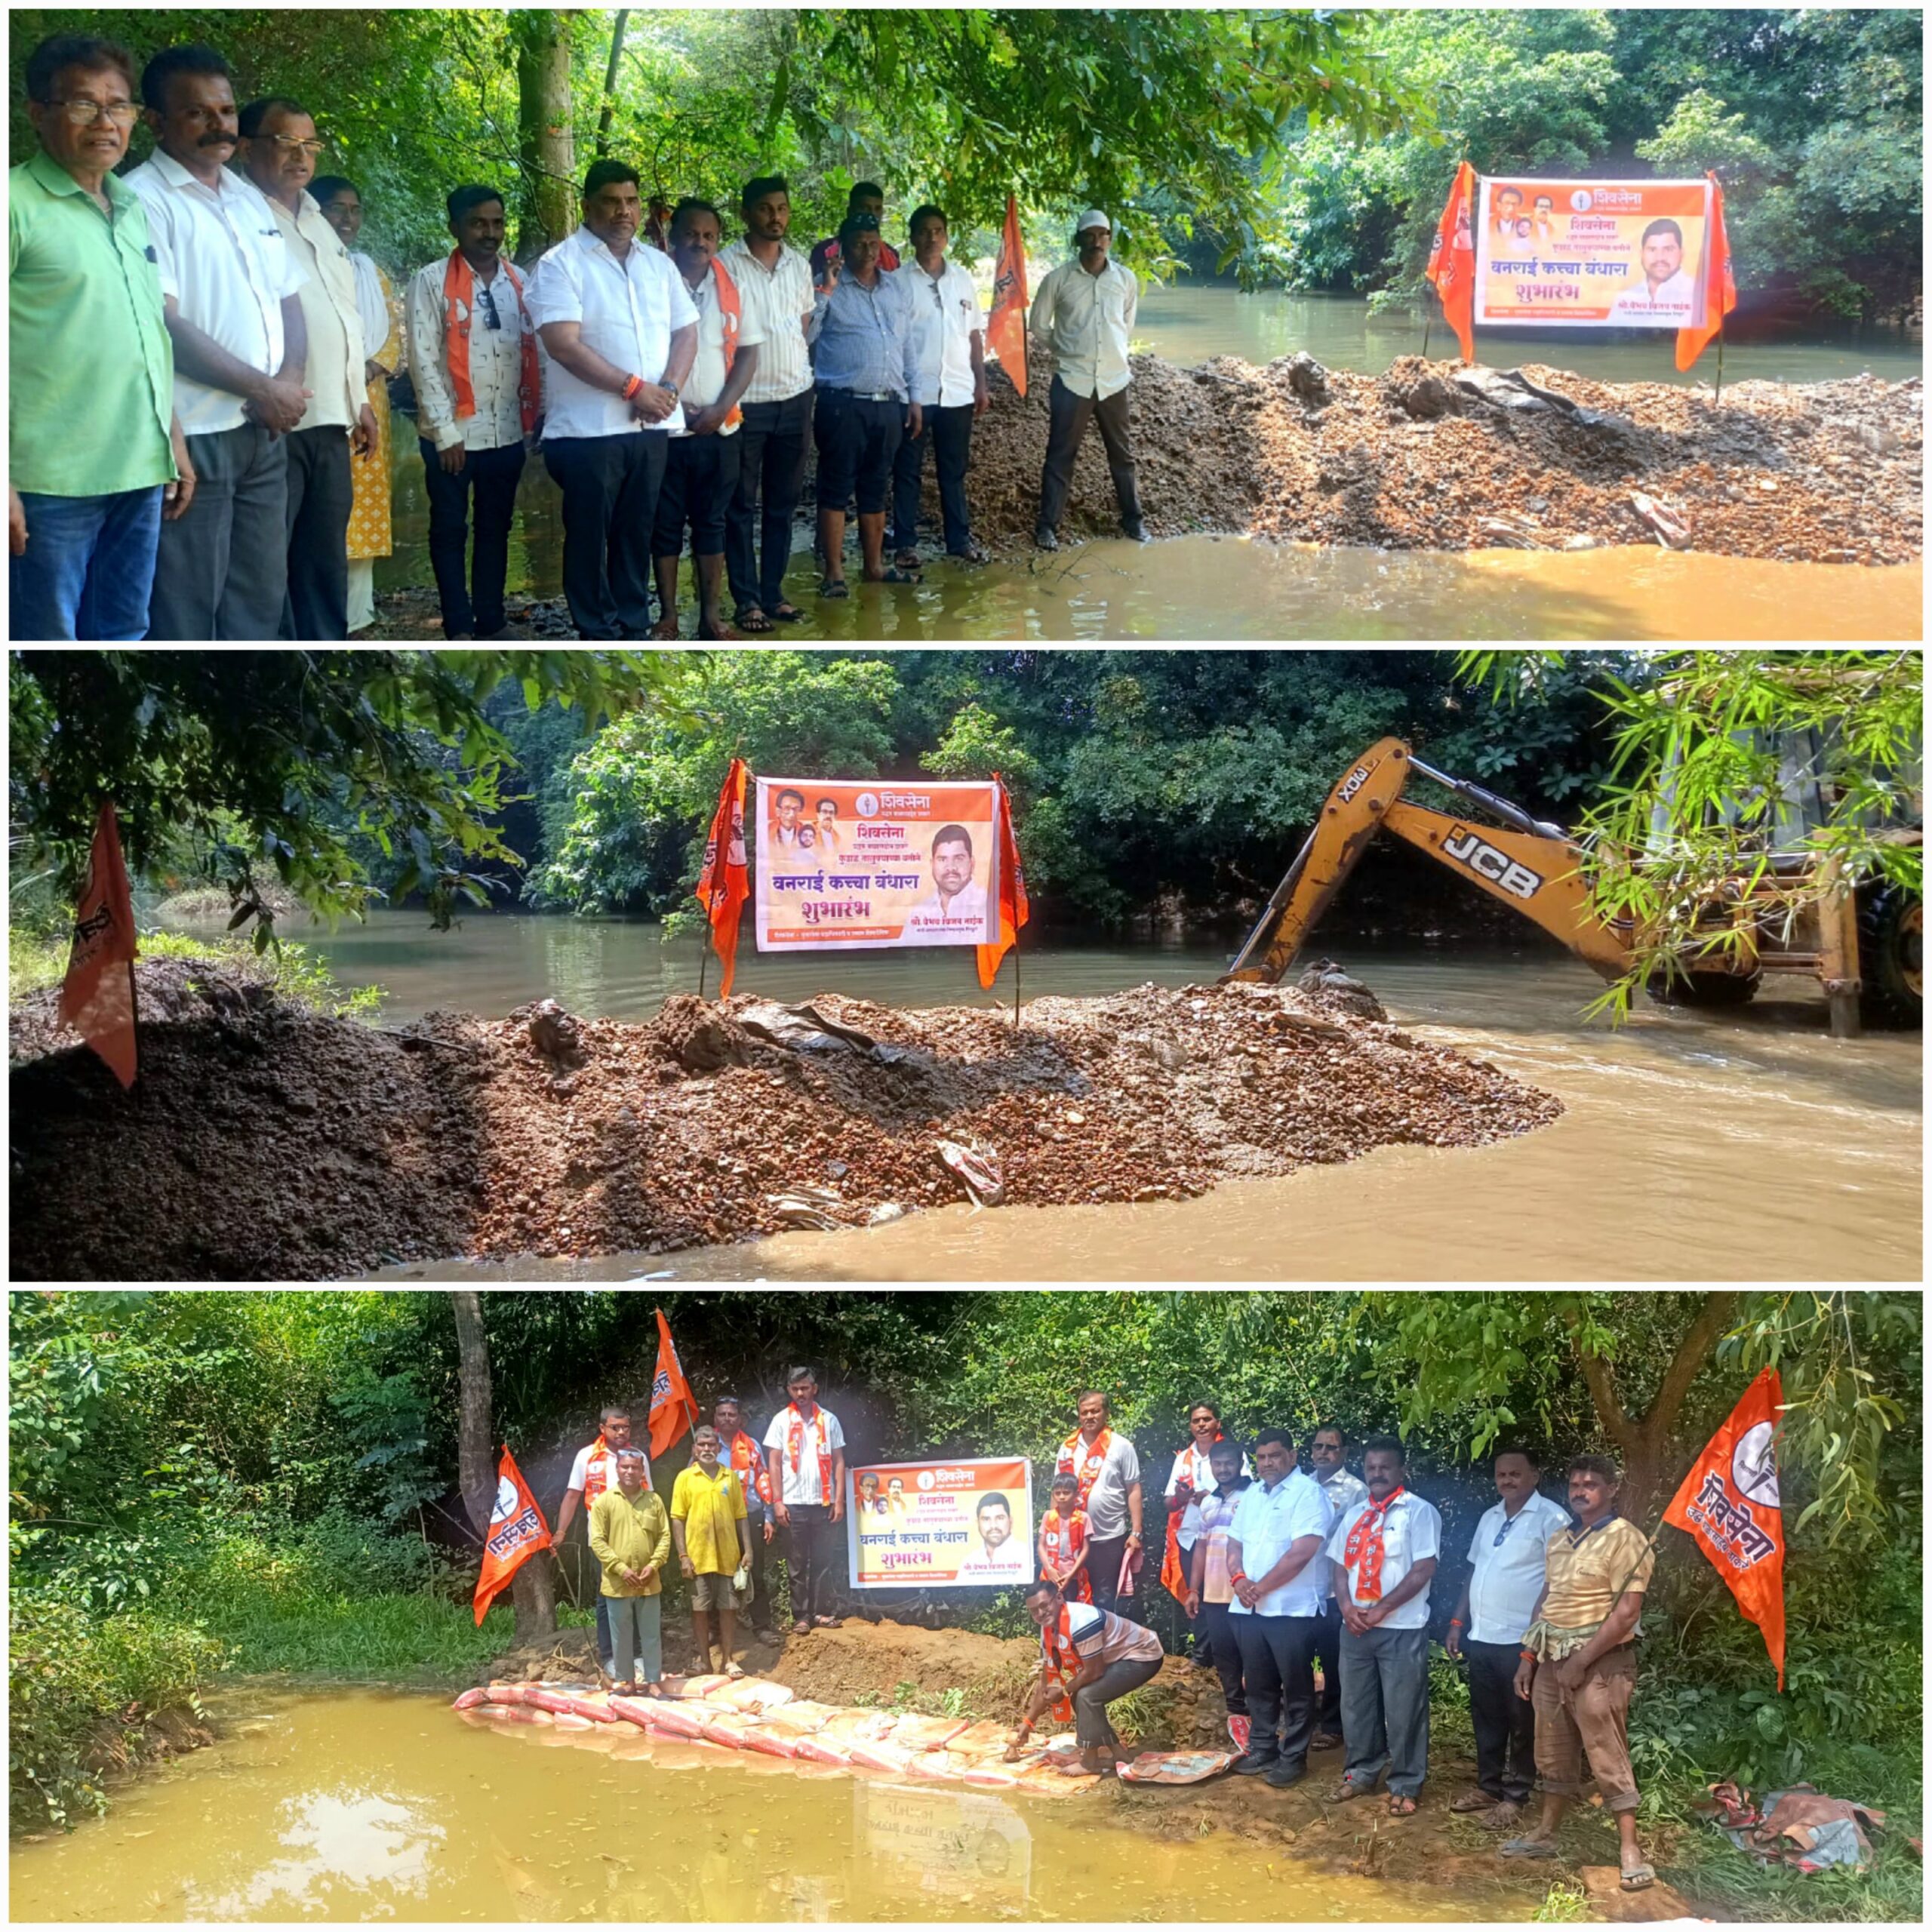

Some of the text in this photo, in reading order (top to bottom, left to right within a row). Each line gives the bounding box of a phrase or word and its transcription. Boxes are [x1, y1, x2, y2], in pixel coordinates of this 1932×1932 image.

[1594, 189, 1641, 205] शिवसेना
[1571, 217, 1616, 230] शिवसेना
[1491, 257, 1628, 276] वनराई कच्चा बंधारा
[1516, 280, 1580, 303] शुभारंभ
[880, 792, 931, 808] शिवसेना
[857, 823, 904, 838] शिवसेना
[1443, 833, 1540, 899] JCB
[773, 870, 919, 892] वनराई कच्चा बंधारा
[801, 896, 870, 924] शुभारंभ
[1694, 1470, 1775, 1564] शिवसेना
[860, 1528, 968, 1546] वनराई कच्चा बंधारा
[881, 1548, 931, 1569] शुभारंभ
